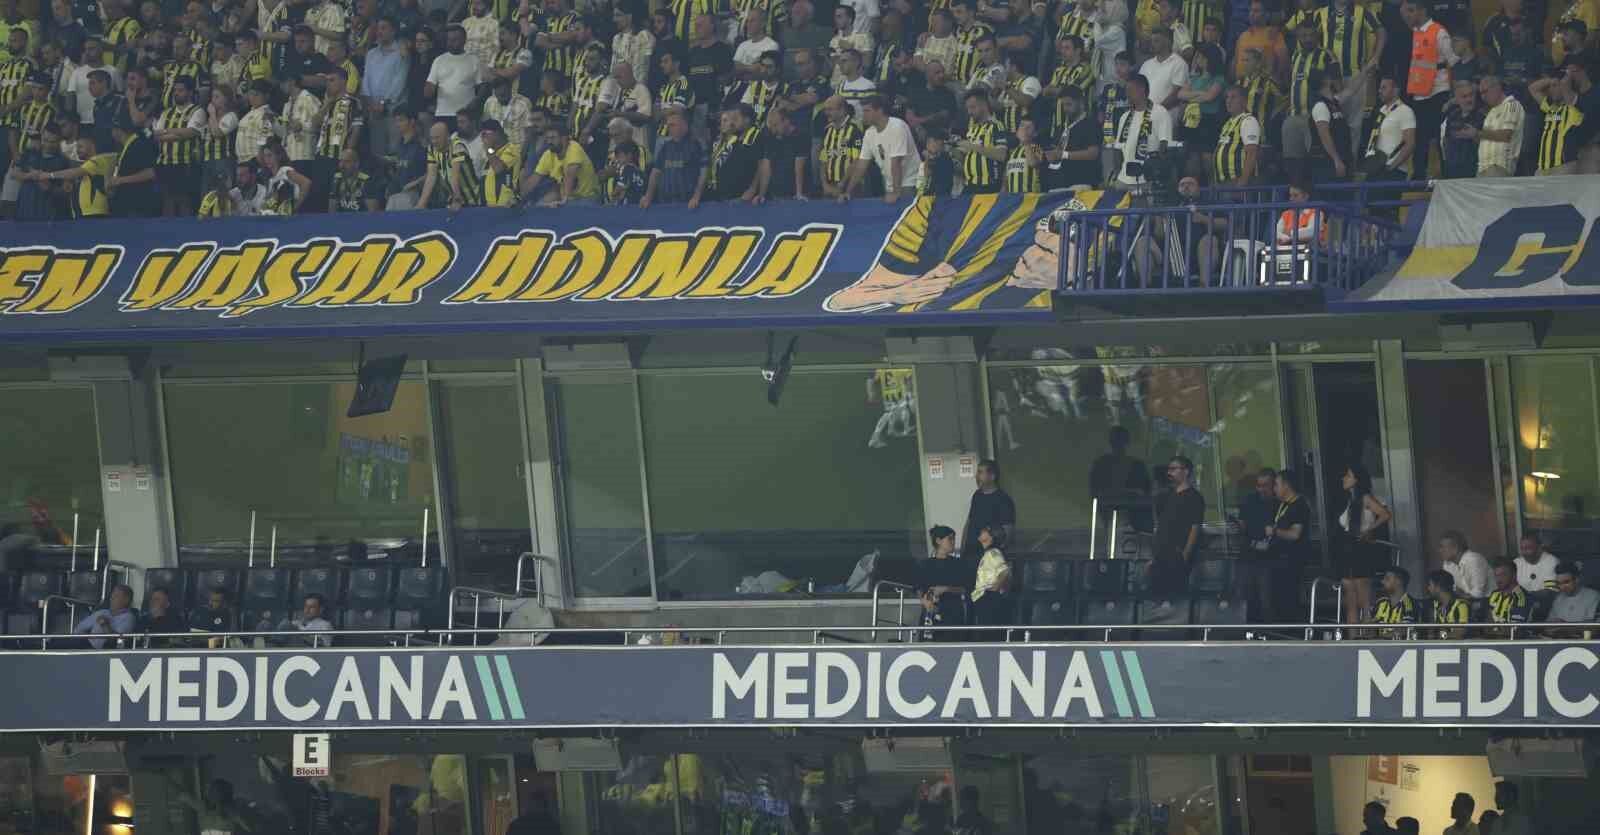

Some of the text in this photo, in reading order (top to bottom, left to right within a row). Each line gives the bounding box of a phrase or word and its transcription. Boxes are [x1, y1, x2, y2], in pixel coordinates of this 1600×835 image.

[440, 223, 845, 305] ADINLA
[1450, 203, 1600, 290] G
[107, 654, 478, 722] MEDICANA
[711, 650, 1105, 719] MEDICANA
[304, 736, 319, 764] E
